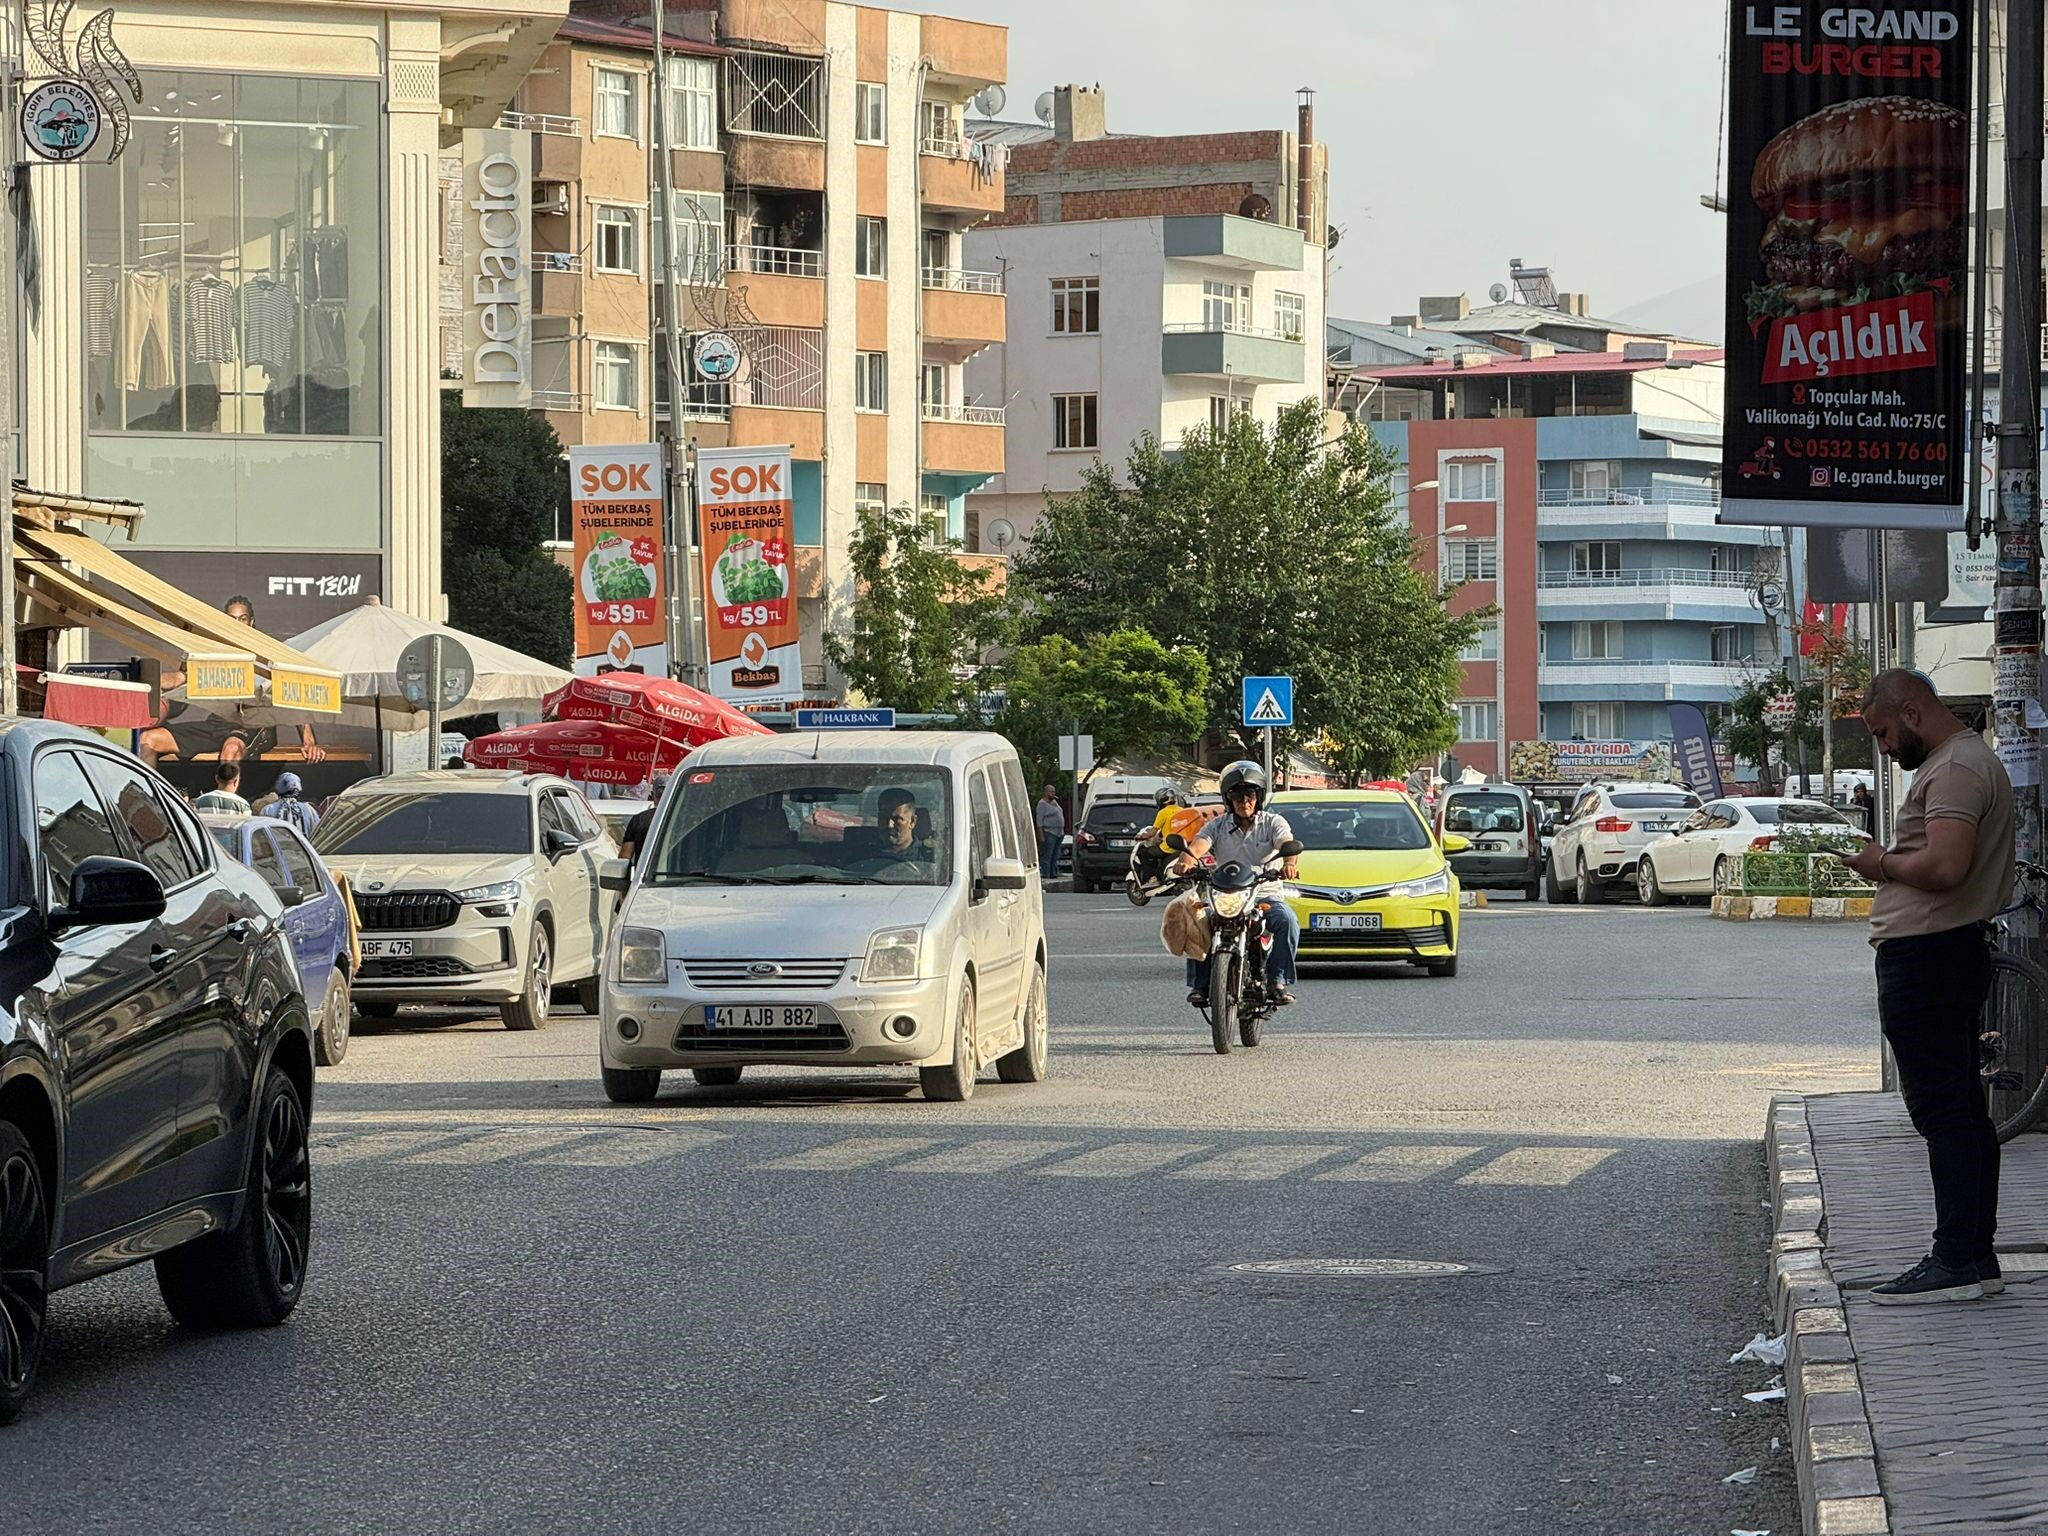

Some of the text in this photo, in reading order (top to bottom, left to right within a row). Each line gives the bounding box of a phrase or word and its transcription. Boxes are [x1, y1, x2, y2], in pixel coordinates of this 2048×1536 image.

[1746, 6, 1958, 40] LE GRAND
[1762, 43, 1941, 78] BURGER
[469, 153, 522, 383] DeFacto
[1780, 309, 1926, 376] Açıldık
[1809, 389, 1906, 407] Topçular Mah.
[1745, 409, 1946, 429] Valikonağı Yolu Cad. No:75/C
[1806, 439, 1946, 461] 0532 561 76 60
[581, 464, 651, 496] ŞOK
[710, 464, 781, 499] ŞOK
[1834, 467, 1945, 489] le.grand.burger
[582, 503, 651, 516] TÜM BEKBAŞ
[711, 505, 781, 518] TÜM BEKBAŞ
[581, 517, 653, 530] ŞUBELERİNDE
[710, 518, 784, 534] ŞUBELERİNDE
[633, 548, 653, 559] TAVUK
[764, 549, 784, 559] TAVUK
[316, 574, 361, 596] TECH
[636, 610, 648, 619] TL
[769, 611, 781, 619] TL
[734, 673, 776, 682] Bekbaş
[824, 713, 879, 723] HALKBANK
[1559, 744, 1631, 755] POLAT GIDA
[1318, 917, 1378, 927] 76 T 0068
[361, 942, 412, 955] ABF 475
[717, 1009, 813, 1026] 41 AJB 882
